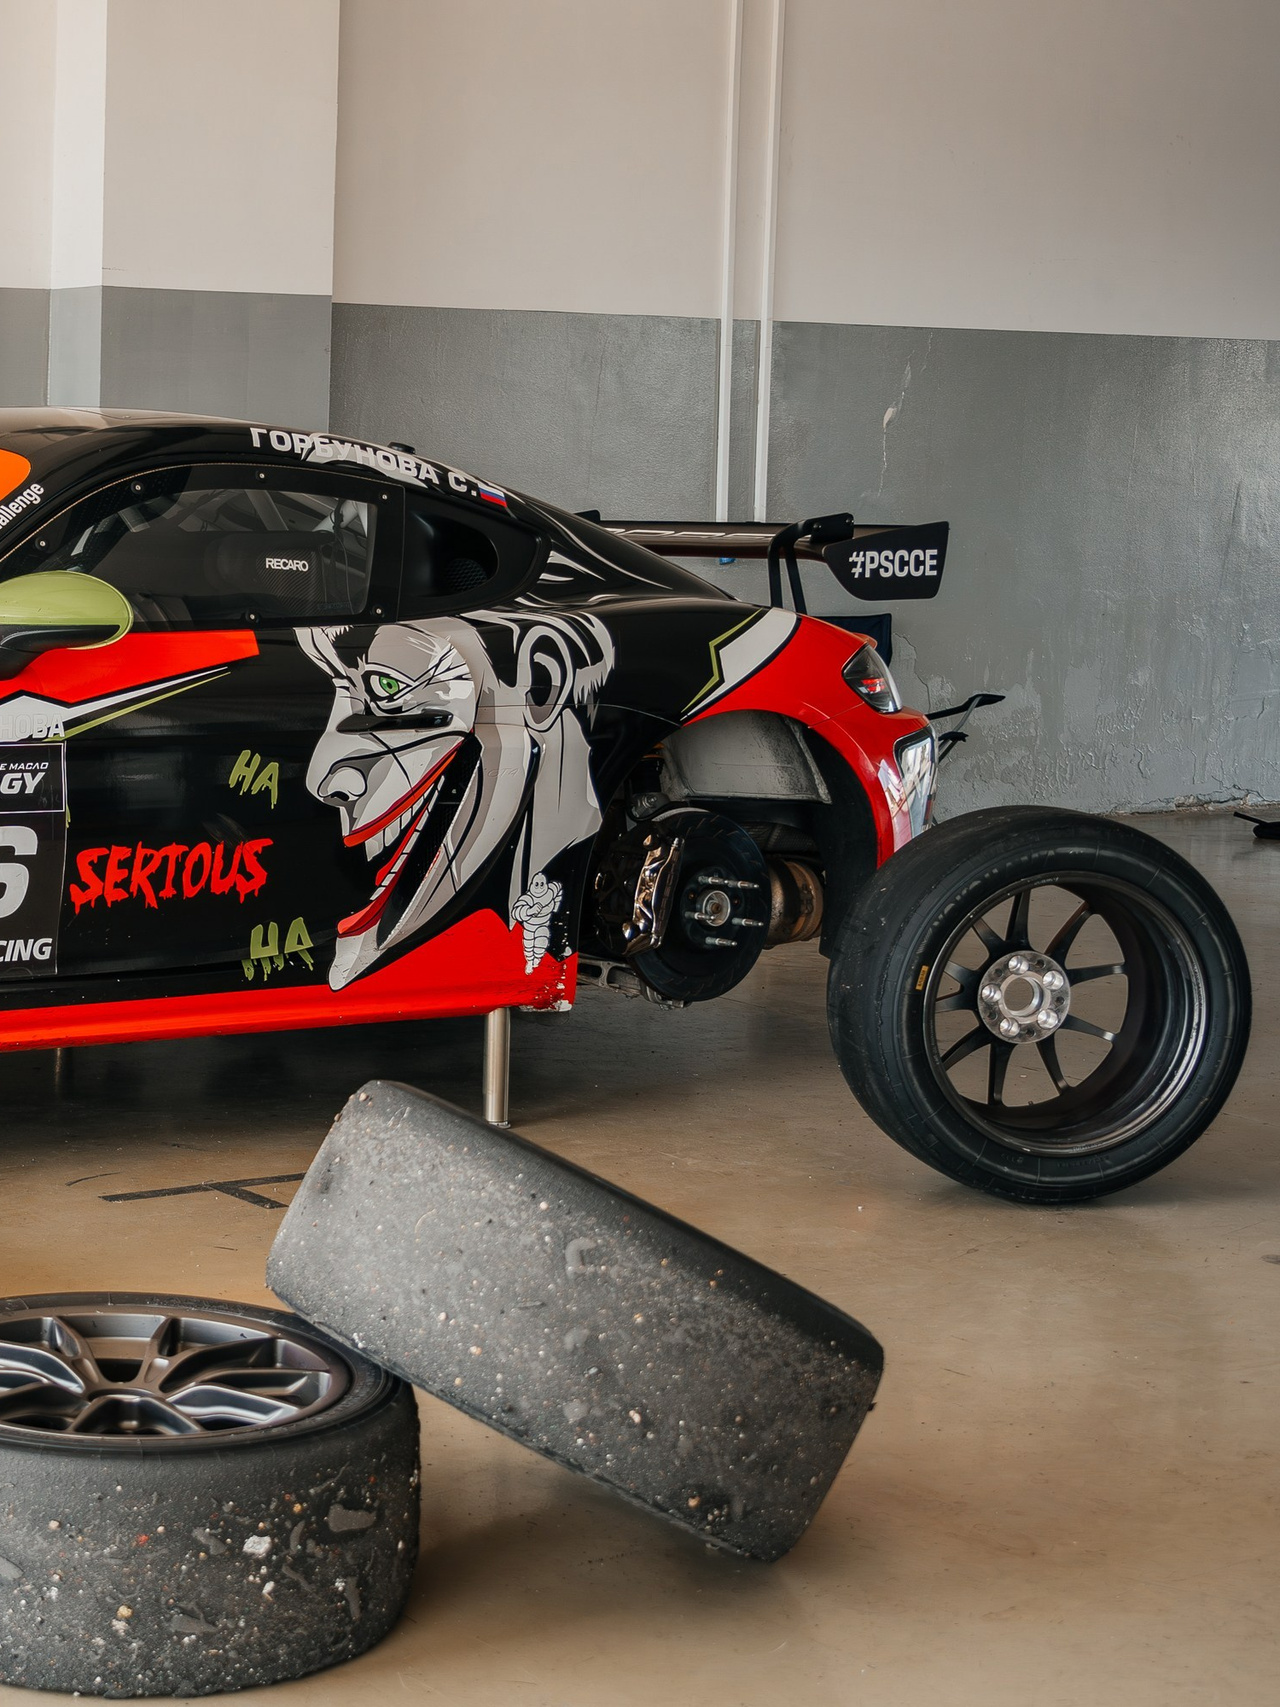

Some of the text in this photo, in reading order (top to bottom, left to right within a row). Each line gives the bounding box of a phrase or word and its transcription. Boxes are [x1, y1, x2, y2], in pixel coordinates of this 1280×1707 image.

[250, 427, 440, 486] ГОРБУНОВА
[265, 557, 309, 572] RECARO
[848, 549, 938, 579] #PSCCE
[9, 762, 49, 771] МАСЛО
[228, 749, 280, 809] HA
[68, 838, 274, 914] SERIOUS
[241, 916, 314, 981] HA
